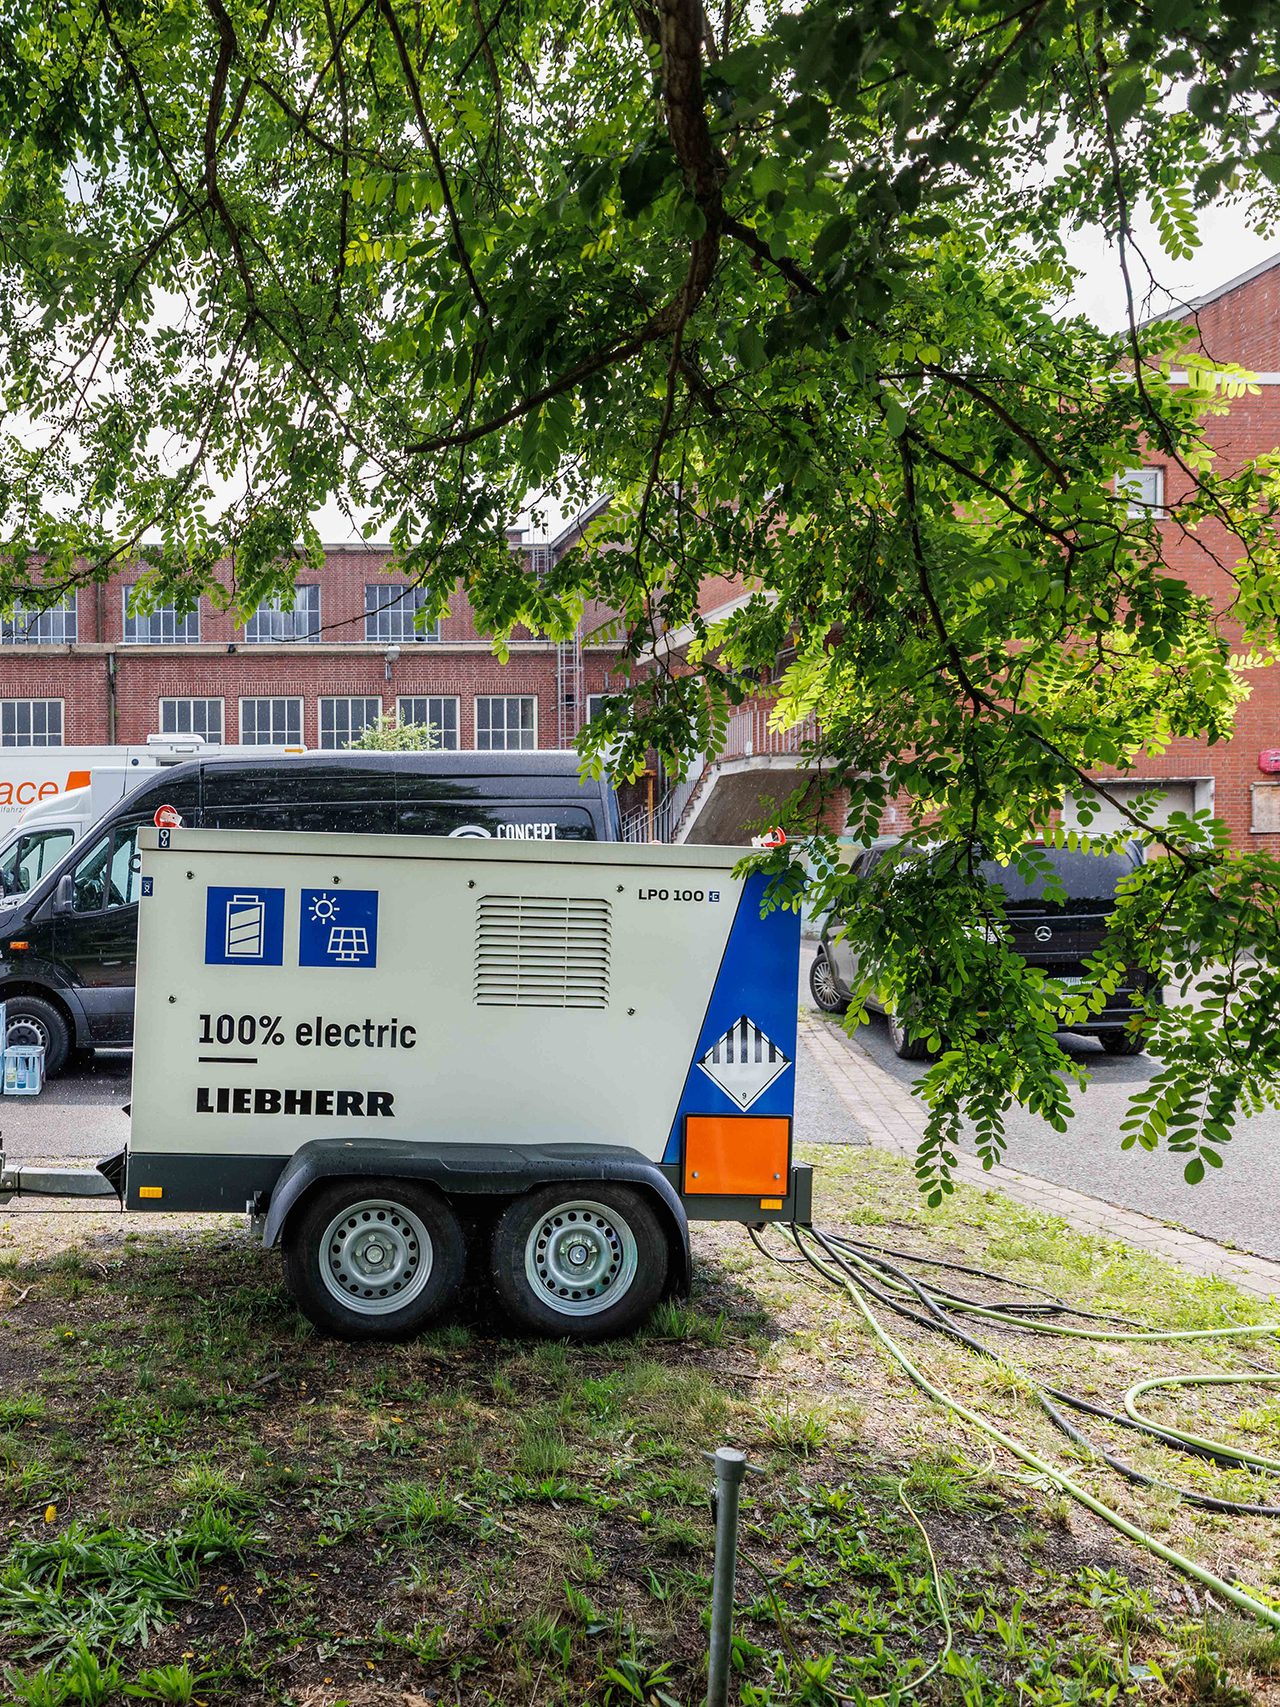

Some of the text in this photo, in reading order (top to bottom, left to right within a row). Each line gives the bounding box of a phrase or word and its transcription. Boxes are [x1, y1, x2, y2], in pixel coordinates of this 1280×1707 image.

[496, 823, 558, 841] CONCEPT
[638, 888, 669, 901] LPO
[673, 889, 705, 902] 100
[198, 1014, 417, 1049] 100% electric
[196, 1087, 396, 1117] LIEBHERR
[741, 1092, 747, 1100] 9
